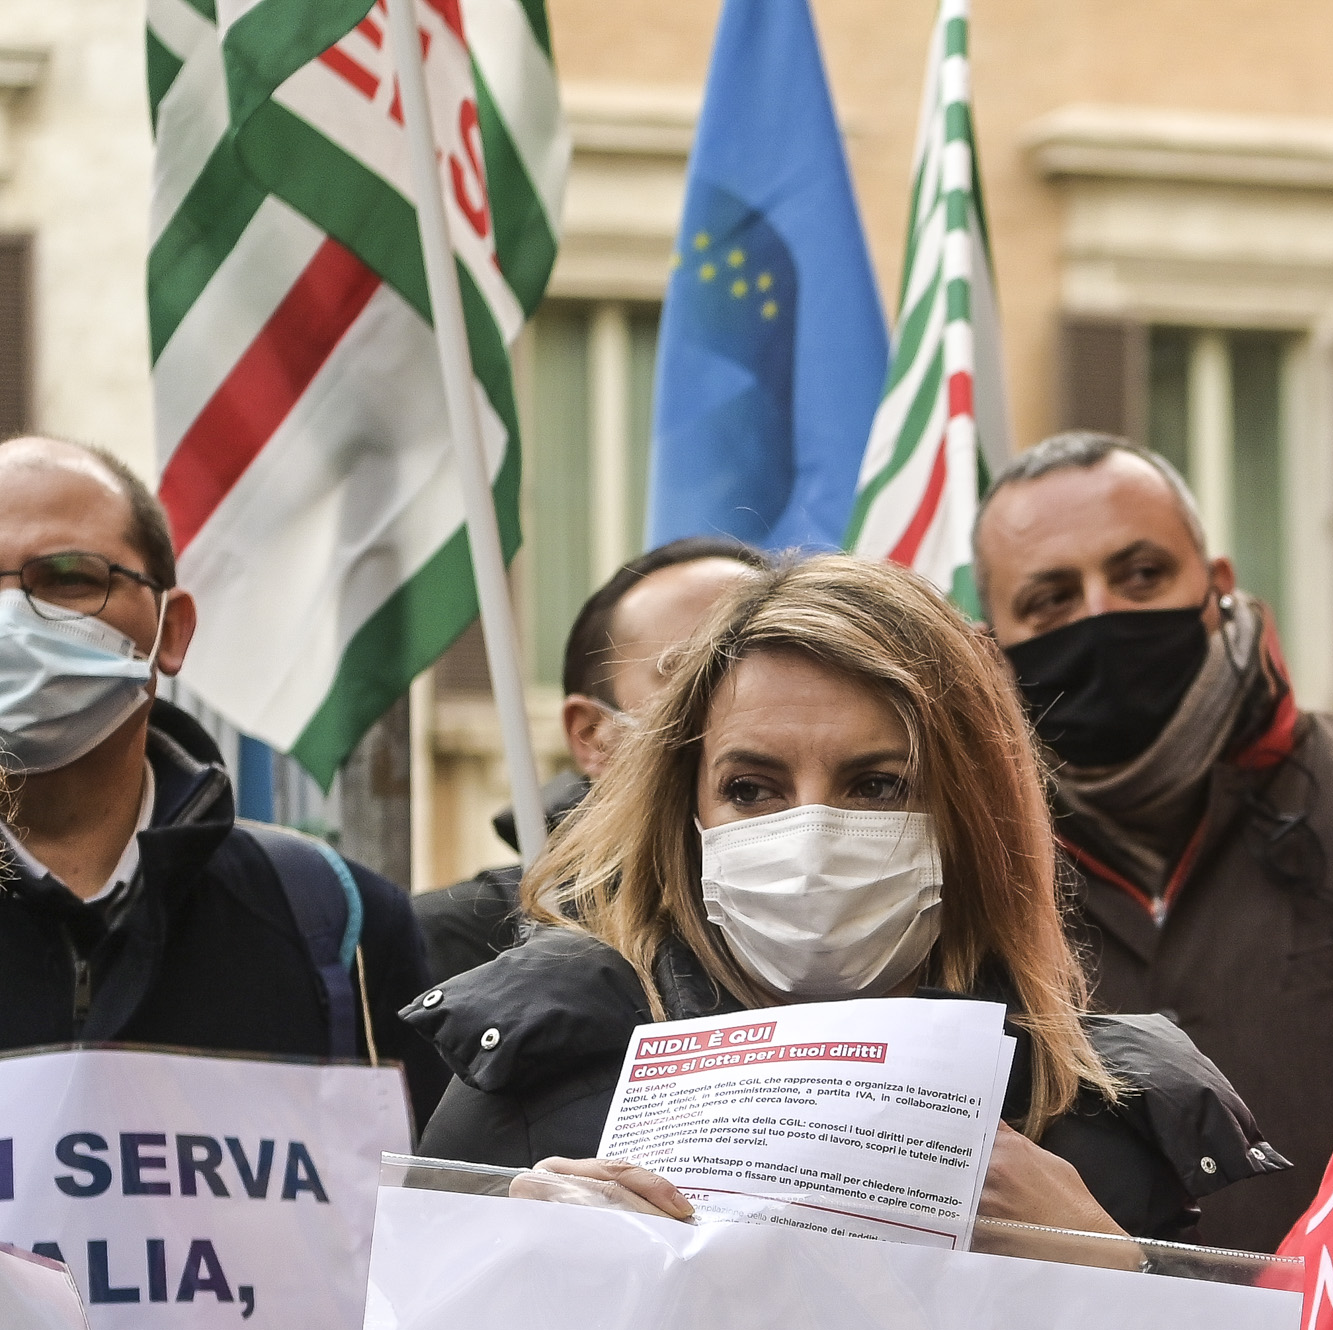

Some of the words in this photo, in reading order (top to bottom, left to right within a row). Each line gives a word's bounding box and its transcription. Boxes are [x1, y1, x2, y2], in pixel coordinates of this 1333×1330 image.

[640, 1037, 701, 1056] NIDIL
[708, 1030, 723, 1047] È
[729, 1026, 772, 1044] QUI
[634, 1064, 678, 1079] dove
[681, 1060, 695, 1071] si
[699, 1054, 740, 1069] lotta
[744, 1050, 774, 1063] per
[789, 1045, 825, 1058] tuoi
[830, 1044, 883, 1059] diritti
[620, 1101, 663, 1112] lavoratori
[714, 1085, 800, 1098] somministrazione,
[817, 1088, 850, 1098] partita
[855, 1091, 876, 1101] IVA,
[896, 1096, 971, 1119] collaborazione,
[626, 1087, 642, 1095] CHI
[645, 1083, 676, 1093] SIAMO
[669, 1085, 711, 1097] categoria
[739, 1078, 761, 1086] CGIL
[764, 1076, 781, 1084] che
[784, 1076, 843, 1087] rappresenta
[854, 1080, 903, 1092] organizza
[918, 1086, 967, 1104] lavoratrici
[702, 1100, 728, 1108] perso
[784, 1096, 818, 1106] lavoro.
[612, 1128, 653, 1140] Partecipa
[656, 1118, 710, 1132] attivamente
[753, 1117, 777, 1126] della
[809, 1121, 847, 1133] conosci
[855, 1127, 875, 1137] tuoi
[877, 1130, 904, 1143] diritti
[906, 1137, 924, 1150] per
[926, 1139, 973, 1157] difenderli
[646, 1140, 674, 1149] nostro
[677, 1137, 712, 1145] sistema
[734, 1137, 768, 1147] servizi.
[752, 1127, 766, 1135] sul
[787, 1131, 816, 1142] posto
[830, 1134, 864, 1149] lavoro,
[865, 1142, 896, 1156] scopri
[909, 1149, 937, 1162] tutele
[940, 1155, 970, 1169] indivi-
[54, 1132, 330, 1204] SERVA
[692, 1156, 743, 1166] Whatsapp
[754, 1160, 798, 1174] mandaci
[800, 1168, 818, 1177] una
[820, 1170, 842, 1181] mail
[843, 1175, 861, 1187] per
[862, 1178, 905, 1195] chiedere
[907, 1186, 962, 1206] informazio-
[685, 1166, 732, 1177] problema
[745, 1170, 776, 1182] fissare
[779, 1176, 792, 1185] un
[793, 1179, 867, 1200] appuntamento
[877, 1194, 907, 1209] capire
[910, 1202, 936, 1214] come
[770, 1215, 829, 1232] dichiarazione
